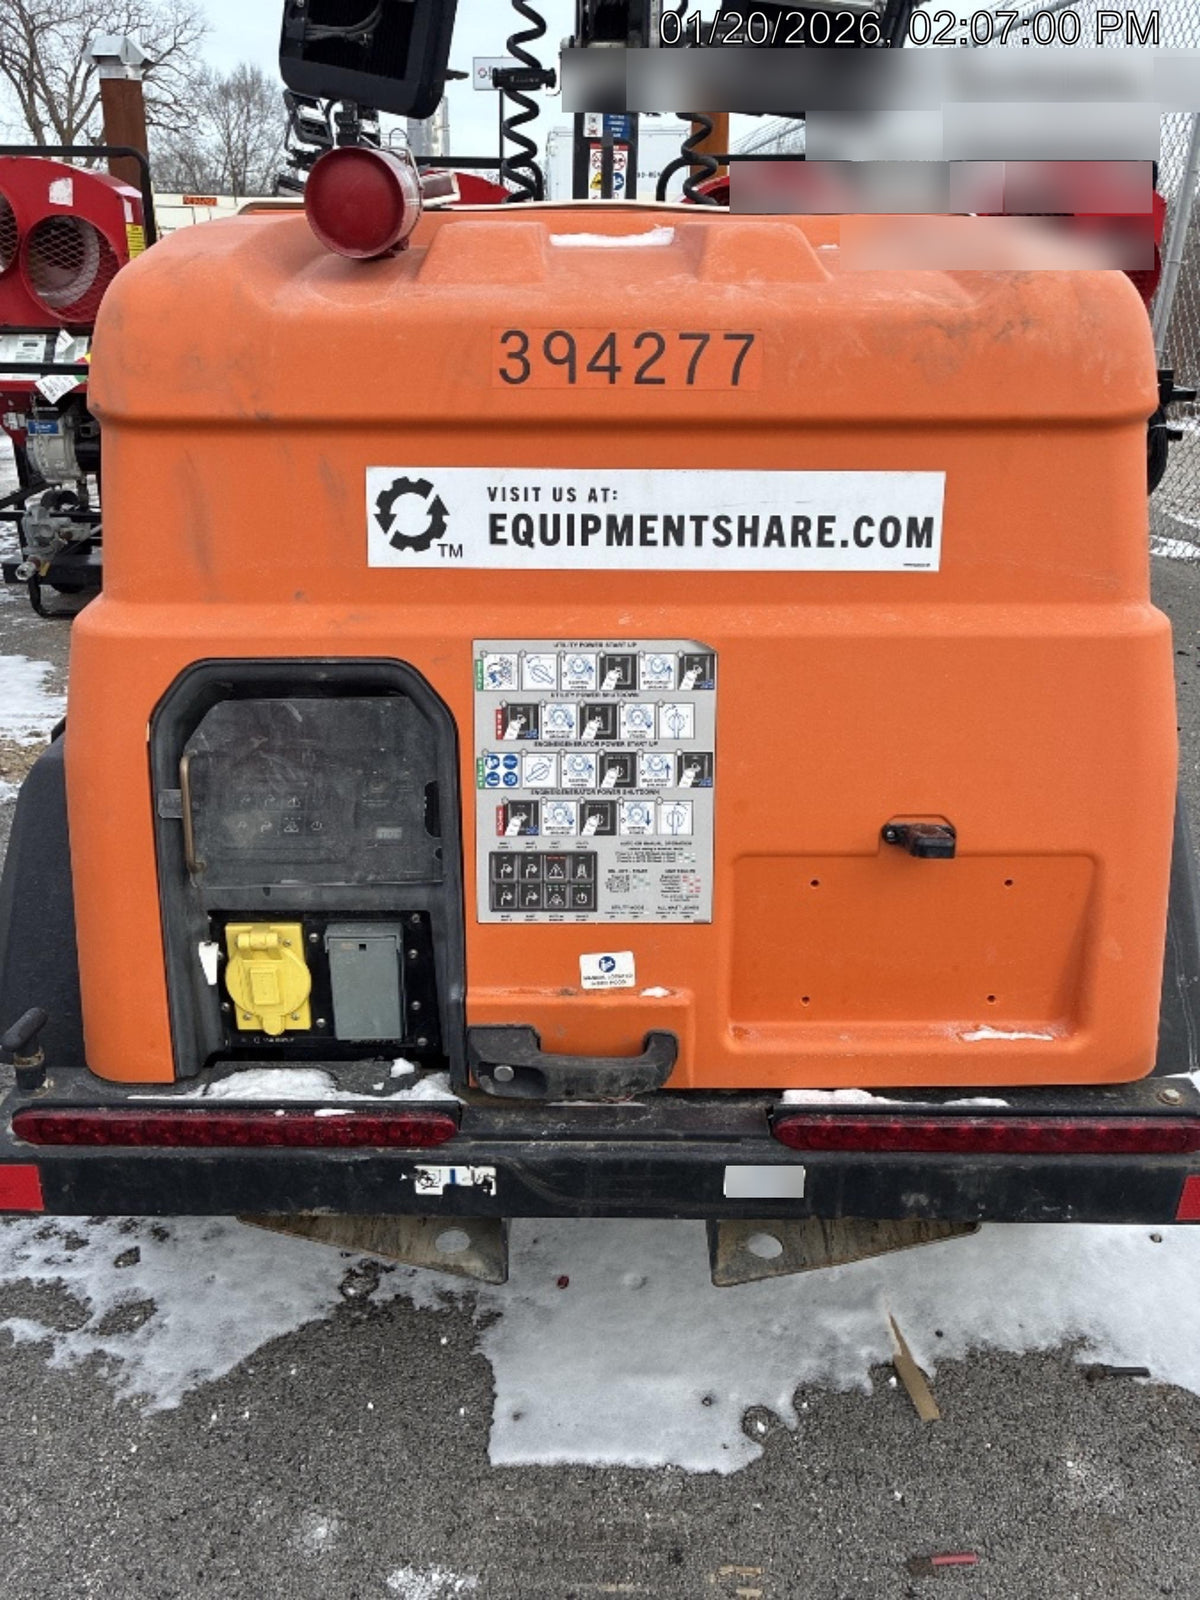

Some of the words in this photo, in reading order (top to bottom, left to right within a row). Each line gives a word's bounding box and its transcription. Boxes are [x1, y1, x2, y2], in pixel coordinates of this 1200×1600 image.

[499, 330, 755, 386] 394277
[487, 486, 542, 502] VISIT
[552, 487, 577, 502] US
[587, 488, 618, 502] AT:
[488, 513, 934, 549] EQUIPMENTSHARE.COM
[438, 543, 463, 558] TM
